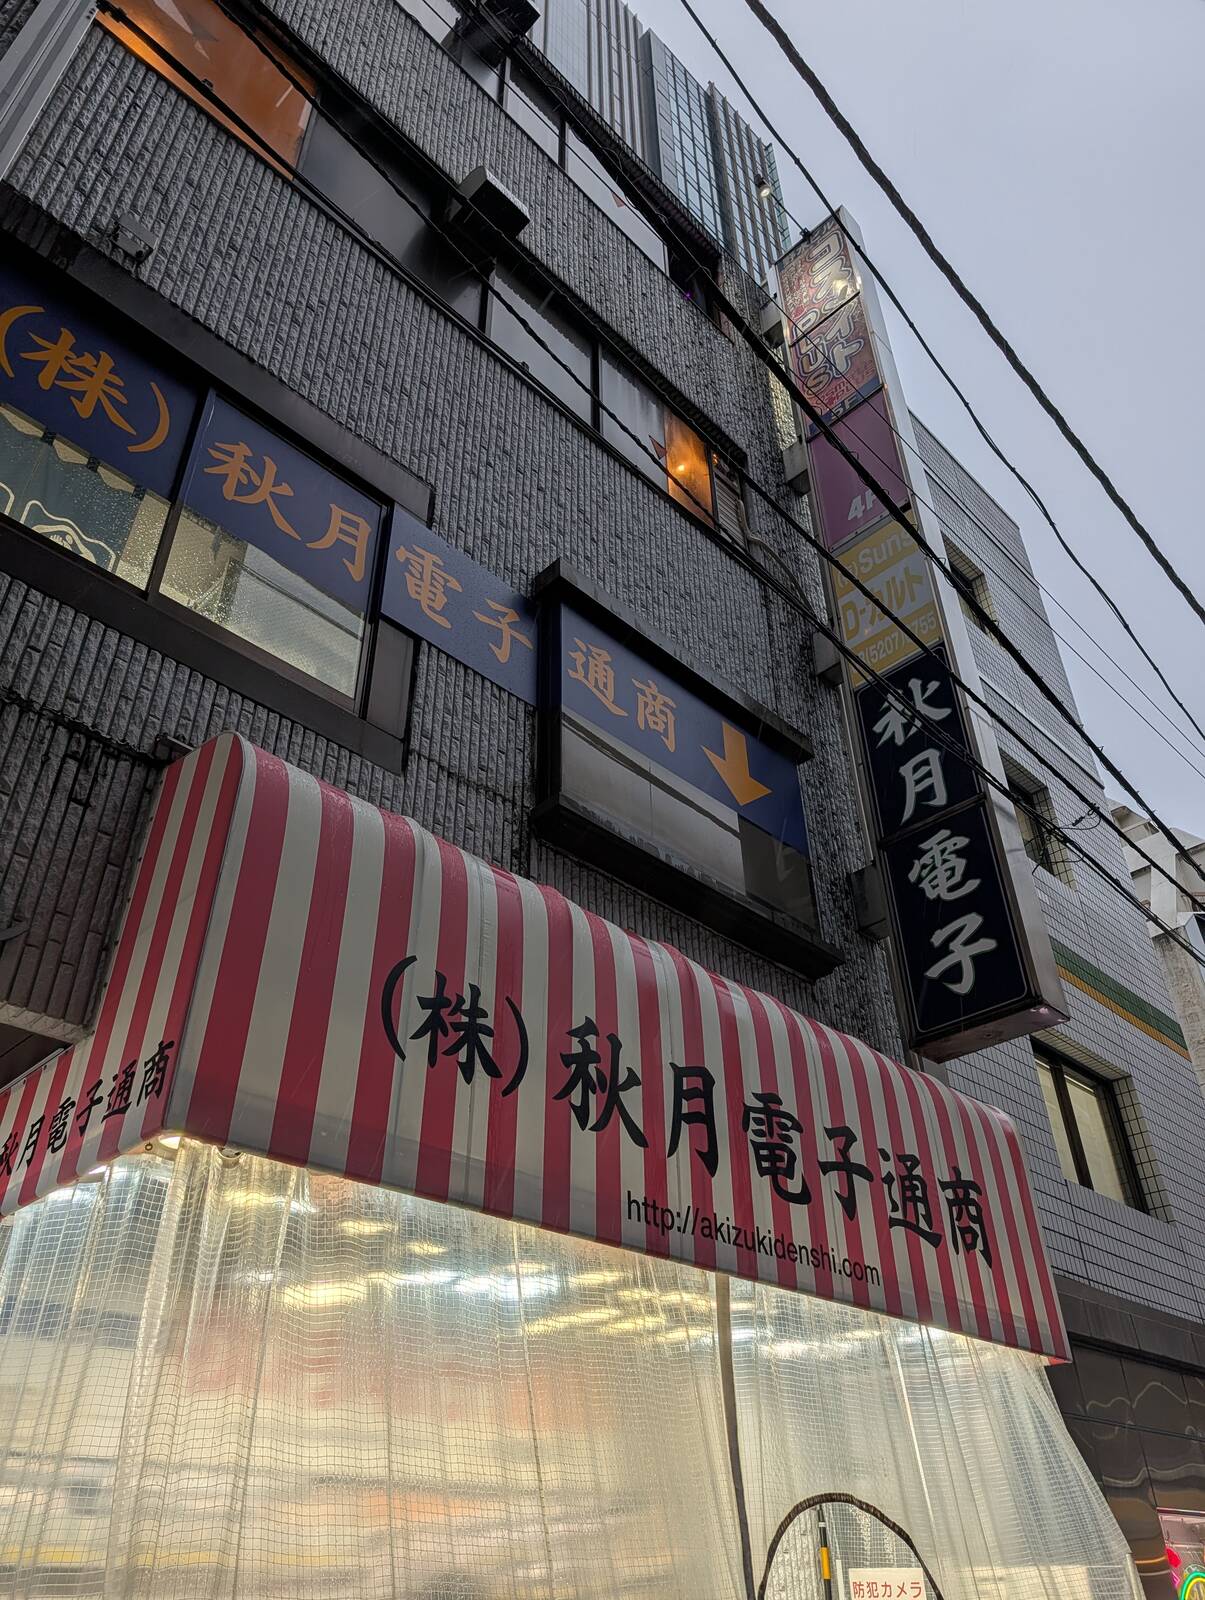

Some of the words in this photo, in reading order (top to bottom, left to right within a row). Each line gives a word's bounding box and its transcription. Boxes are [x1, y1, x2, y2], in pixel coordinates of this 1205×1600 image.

[872, 678, 998, 996] 秋月電子
[626, 1190, 882, 1287] http://akizukidenshi.com
[852, 1581, 922, 1599] 防犯カメラ
